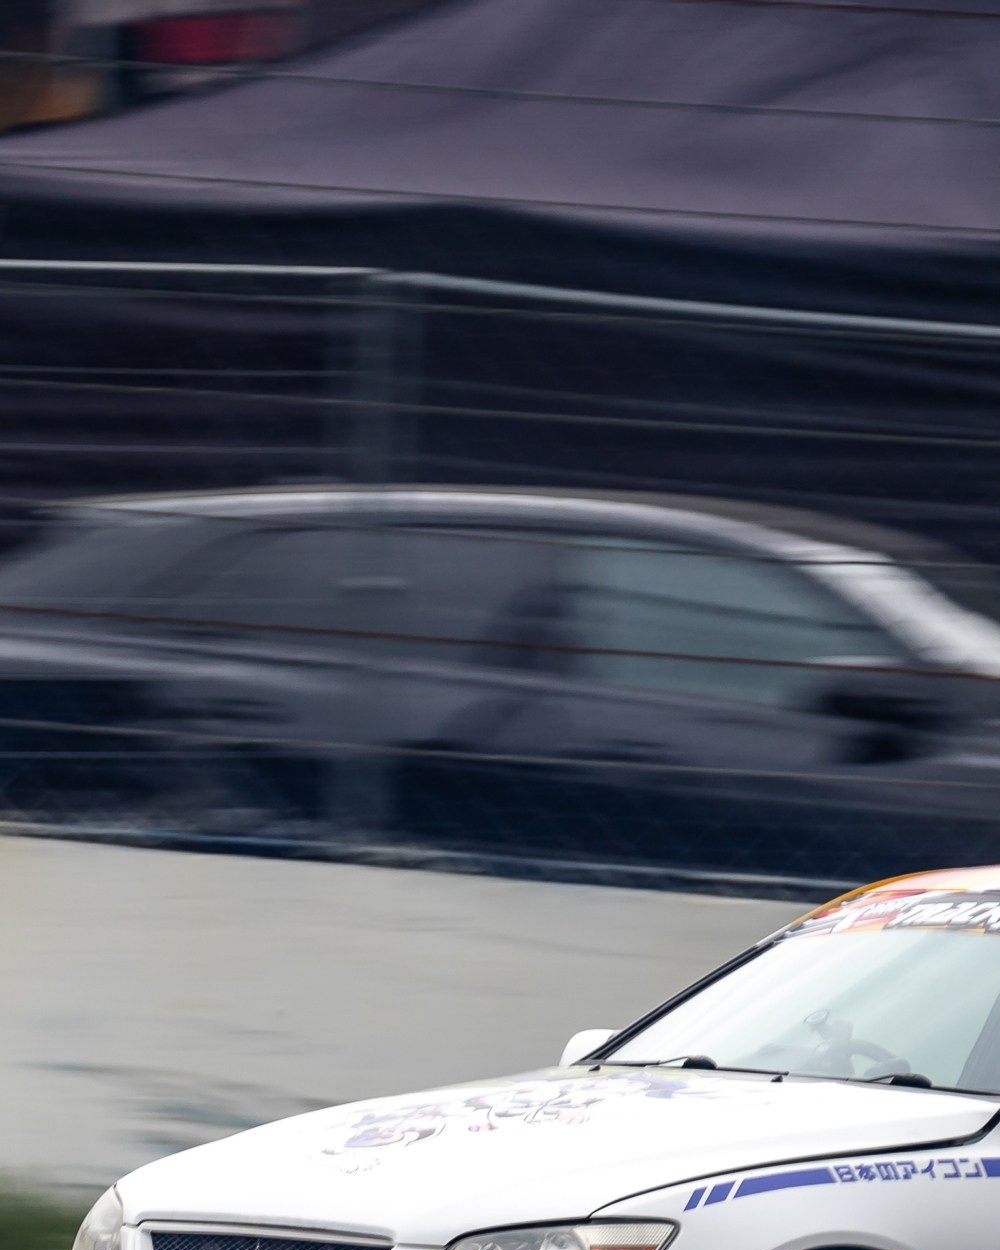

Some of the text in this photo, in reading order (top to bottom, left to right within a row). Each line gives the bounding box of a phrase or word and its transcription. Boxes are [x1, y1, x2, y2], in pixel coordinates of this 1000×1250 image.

[833, 1158, 982, 1183] 日本のアイコン
